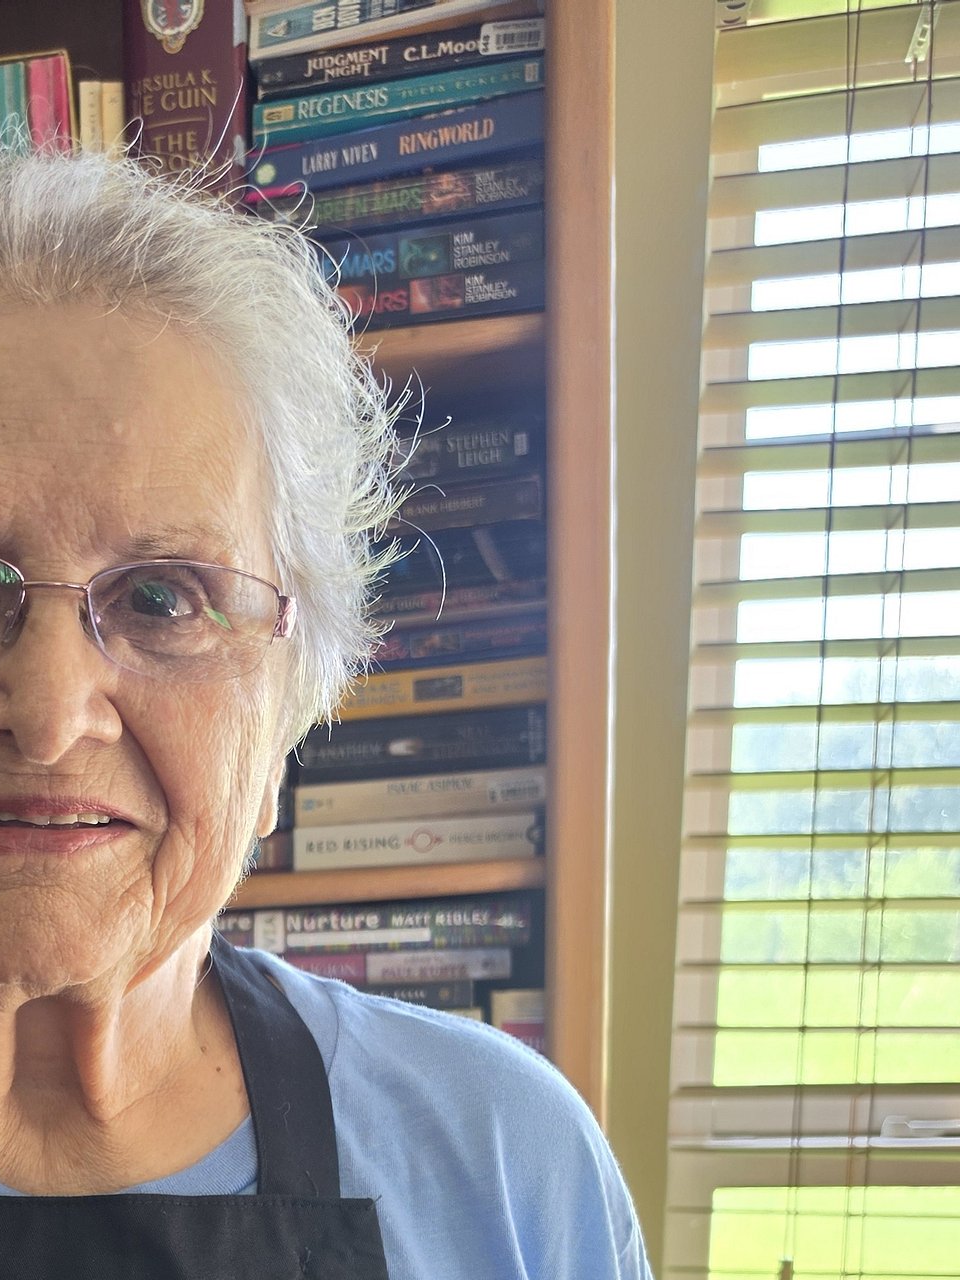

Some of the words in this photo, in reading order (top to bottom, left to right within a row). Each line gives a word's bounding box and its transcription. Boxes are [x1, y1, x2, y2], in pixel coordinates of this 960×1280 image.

[304, 48, 389, 78] JUDGMENT
[324, 63, 372, 83] NIGHT
[160, 87, 217, 112] GUIN
[297, 87, 389, 121] REGENESIS
[152, 130, 198, 153] THE
[302, 149, 338, 176] LARRY
[341, 142, 378, 167] NIVEN
[398, 118, 496, 156] RINGWORLD
[376, 186, 423, 212] MARS
[453, 232, 474, 247] KIM
[453, 240, 500, 259] STANLEY
[343, 250, 396, 280] MARS
[453, 251, 510, 269] ROBINSON
[446, 429, 509, 453] STEPHEN
[457, 450, 503, 469] LEIGH
[343, 836, 402, 852] RISING
[286, 910, 380, 932] Nurture
